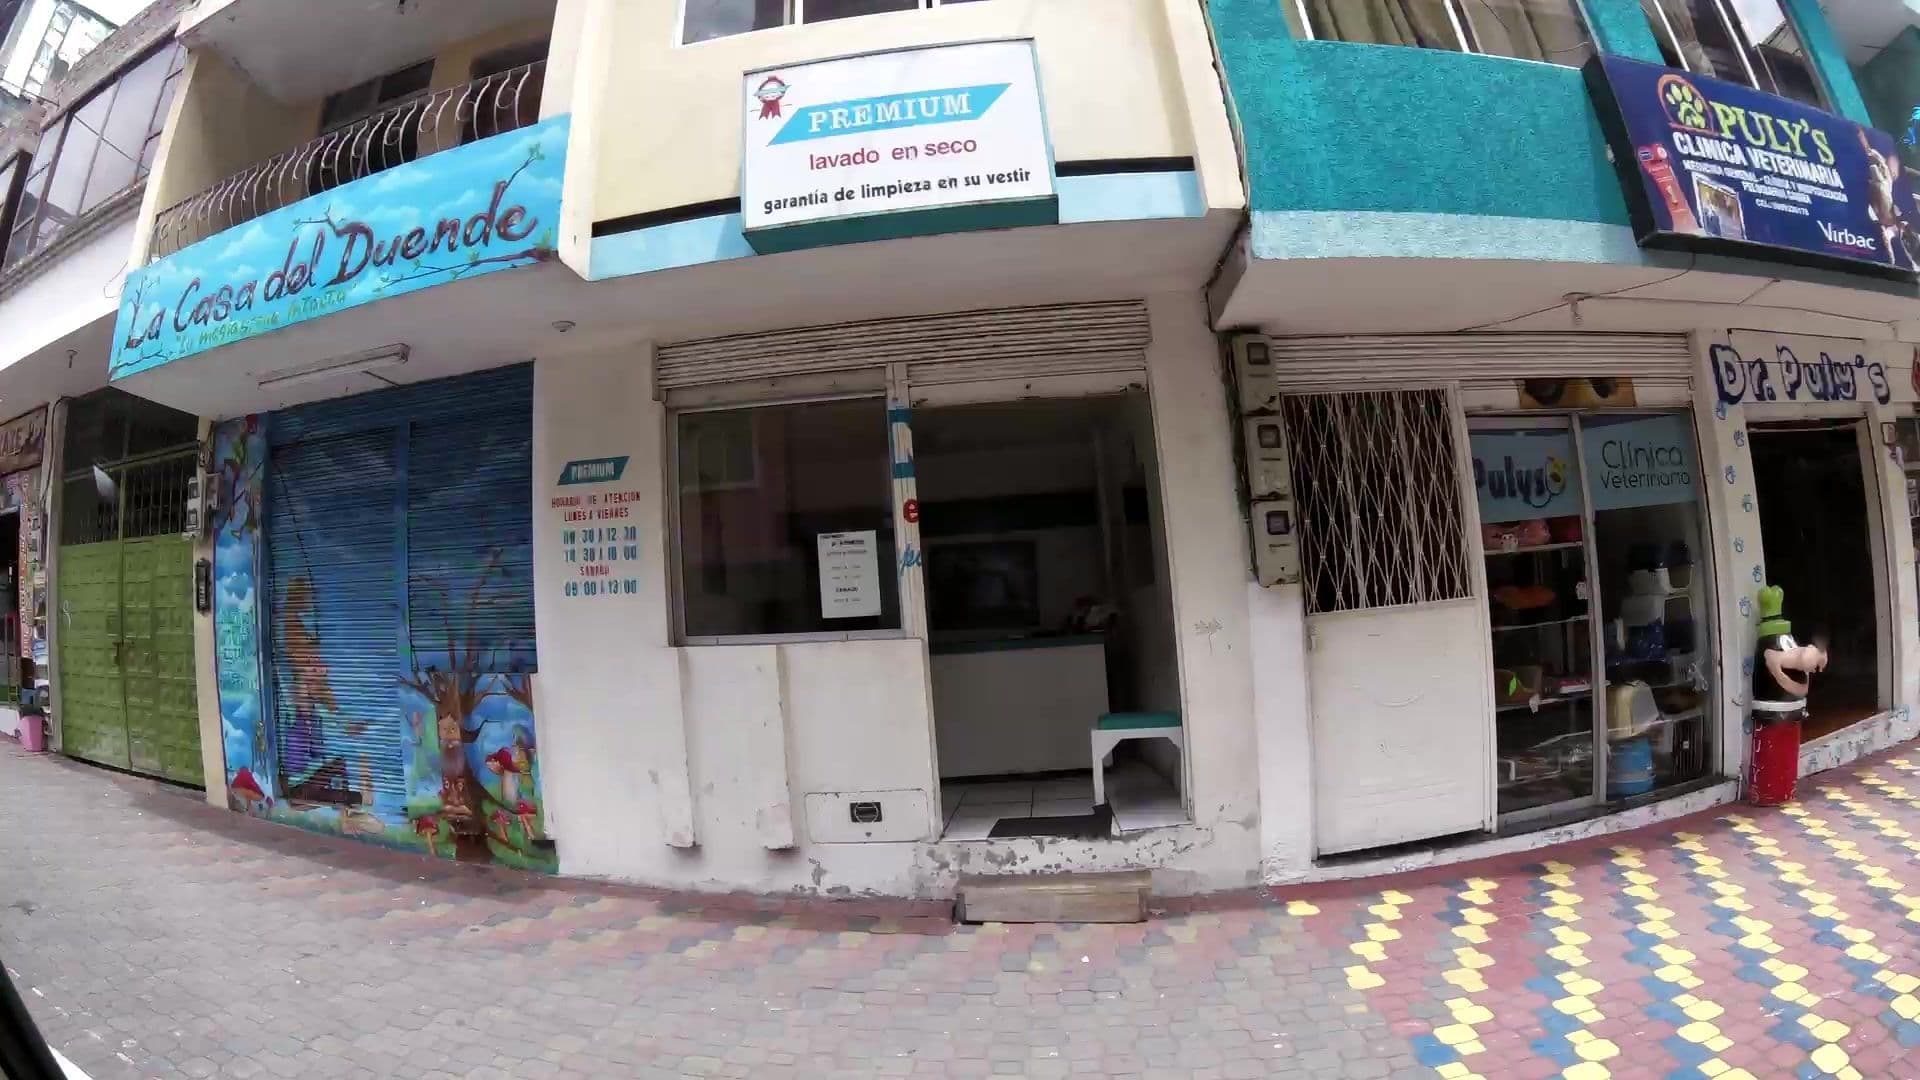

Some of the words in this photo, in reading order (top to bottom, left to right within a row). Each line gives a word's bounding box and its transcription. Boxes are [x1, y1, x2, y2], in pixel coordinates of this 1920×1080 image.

[808, 91, 972, 133] PREMIUM
[1708, 100, 1836, 166] PULY'S
[810, 148, 880, 170] lavado
[891, 145, 918, 161] en
[924, 138, 978, 157] seco
[1672, 131, 1748, 169] CLINICA
[1745, 147, 1845, 189] VETERINARIA
[764, 188, 828, 214] garantía
[834, 186, 855, 202] de
[862, 178, 931, 200] limpieza
[938, 175, 958, 190] en
[964, 174, 981, 187] su
[987, 167, 1031, 185] vestir
[1816, 219, 1877, 251] Virbac
[124, 297, 165, 349] La
[173, 277, 259, 333] Casa
[264, 228, 327, 303] del
[325, 180, 538, 286] Duende
[1709, 343, 1777, 405] Dr.
[1776, 344, 1891, 405] Puly's
[571, 461, 615, 481] PREMIUM
